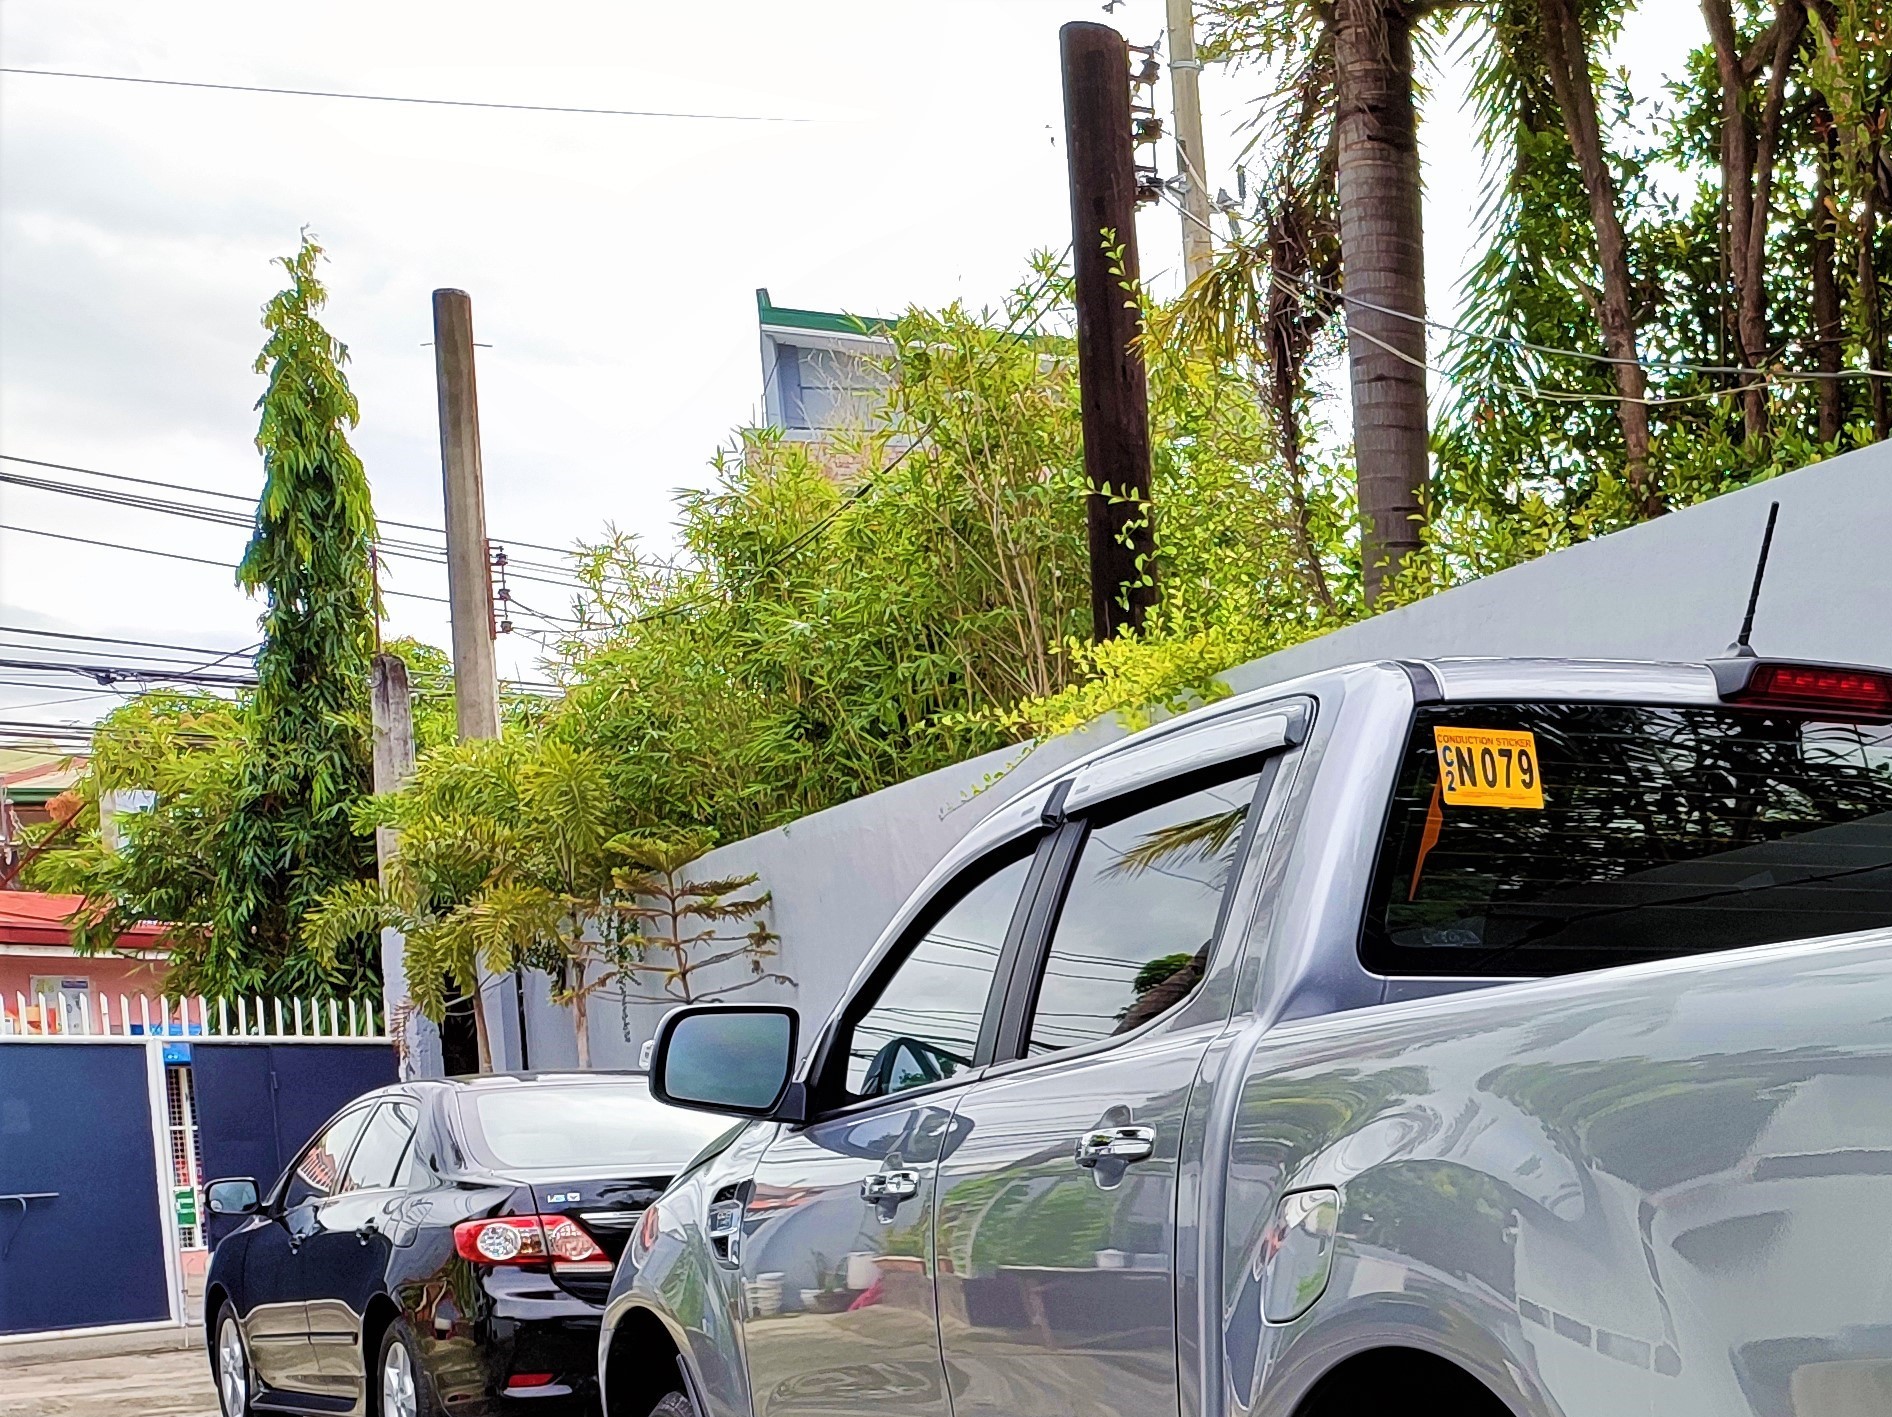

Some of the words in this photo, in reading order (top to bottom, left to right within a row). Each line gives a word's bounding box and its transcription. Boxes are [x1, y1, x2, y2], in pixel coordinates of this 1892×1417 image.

[1437, 734, 1494, 746] CONDUCTION
[1495, 737, 1532, 748] STICKER
[1455, 746, 1534, 790] N079
